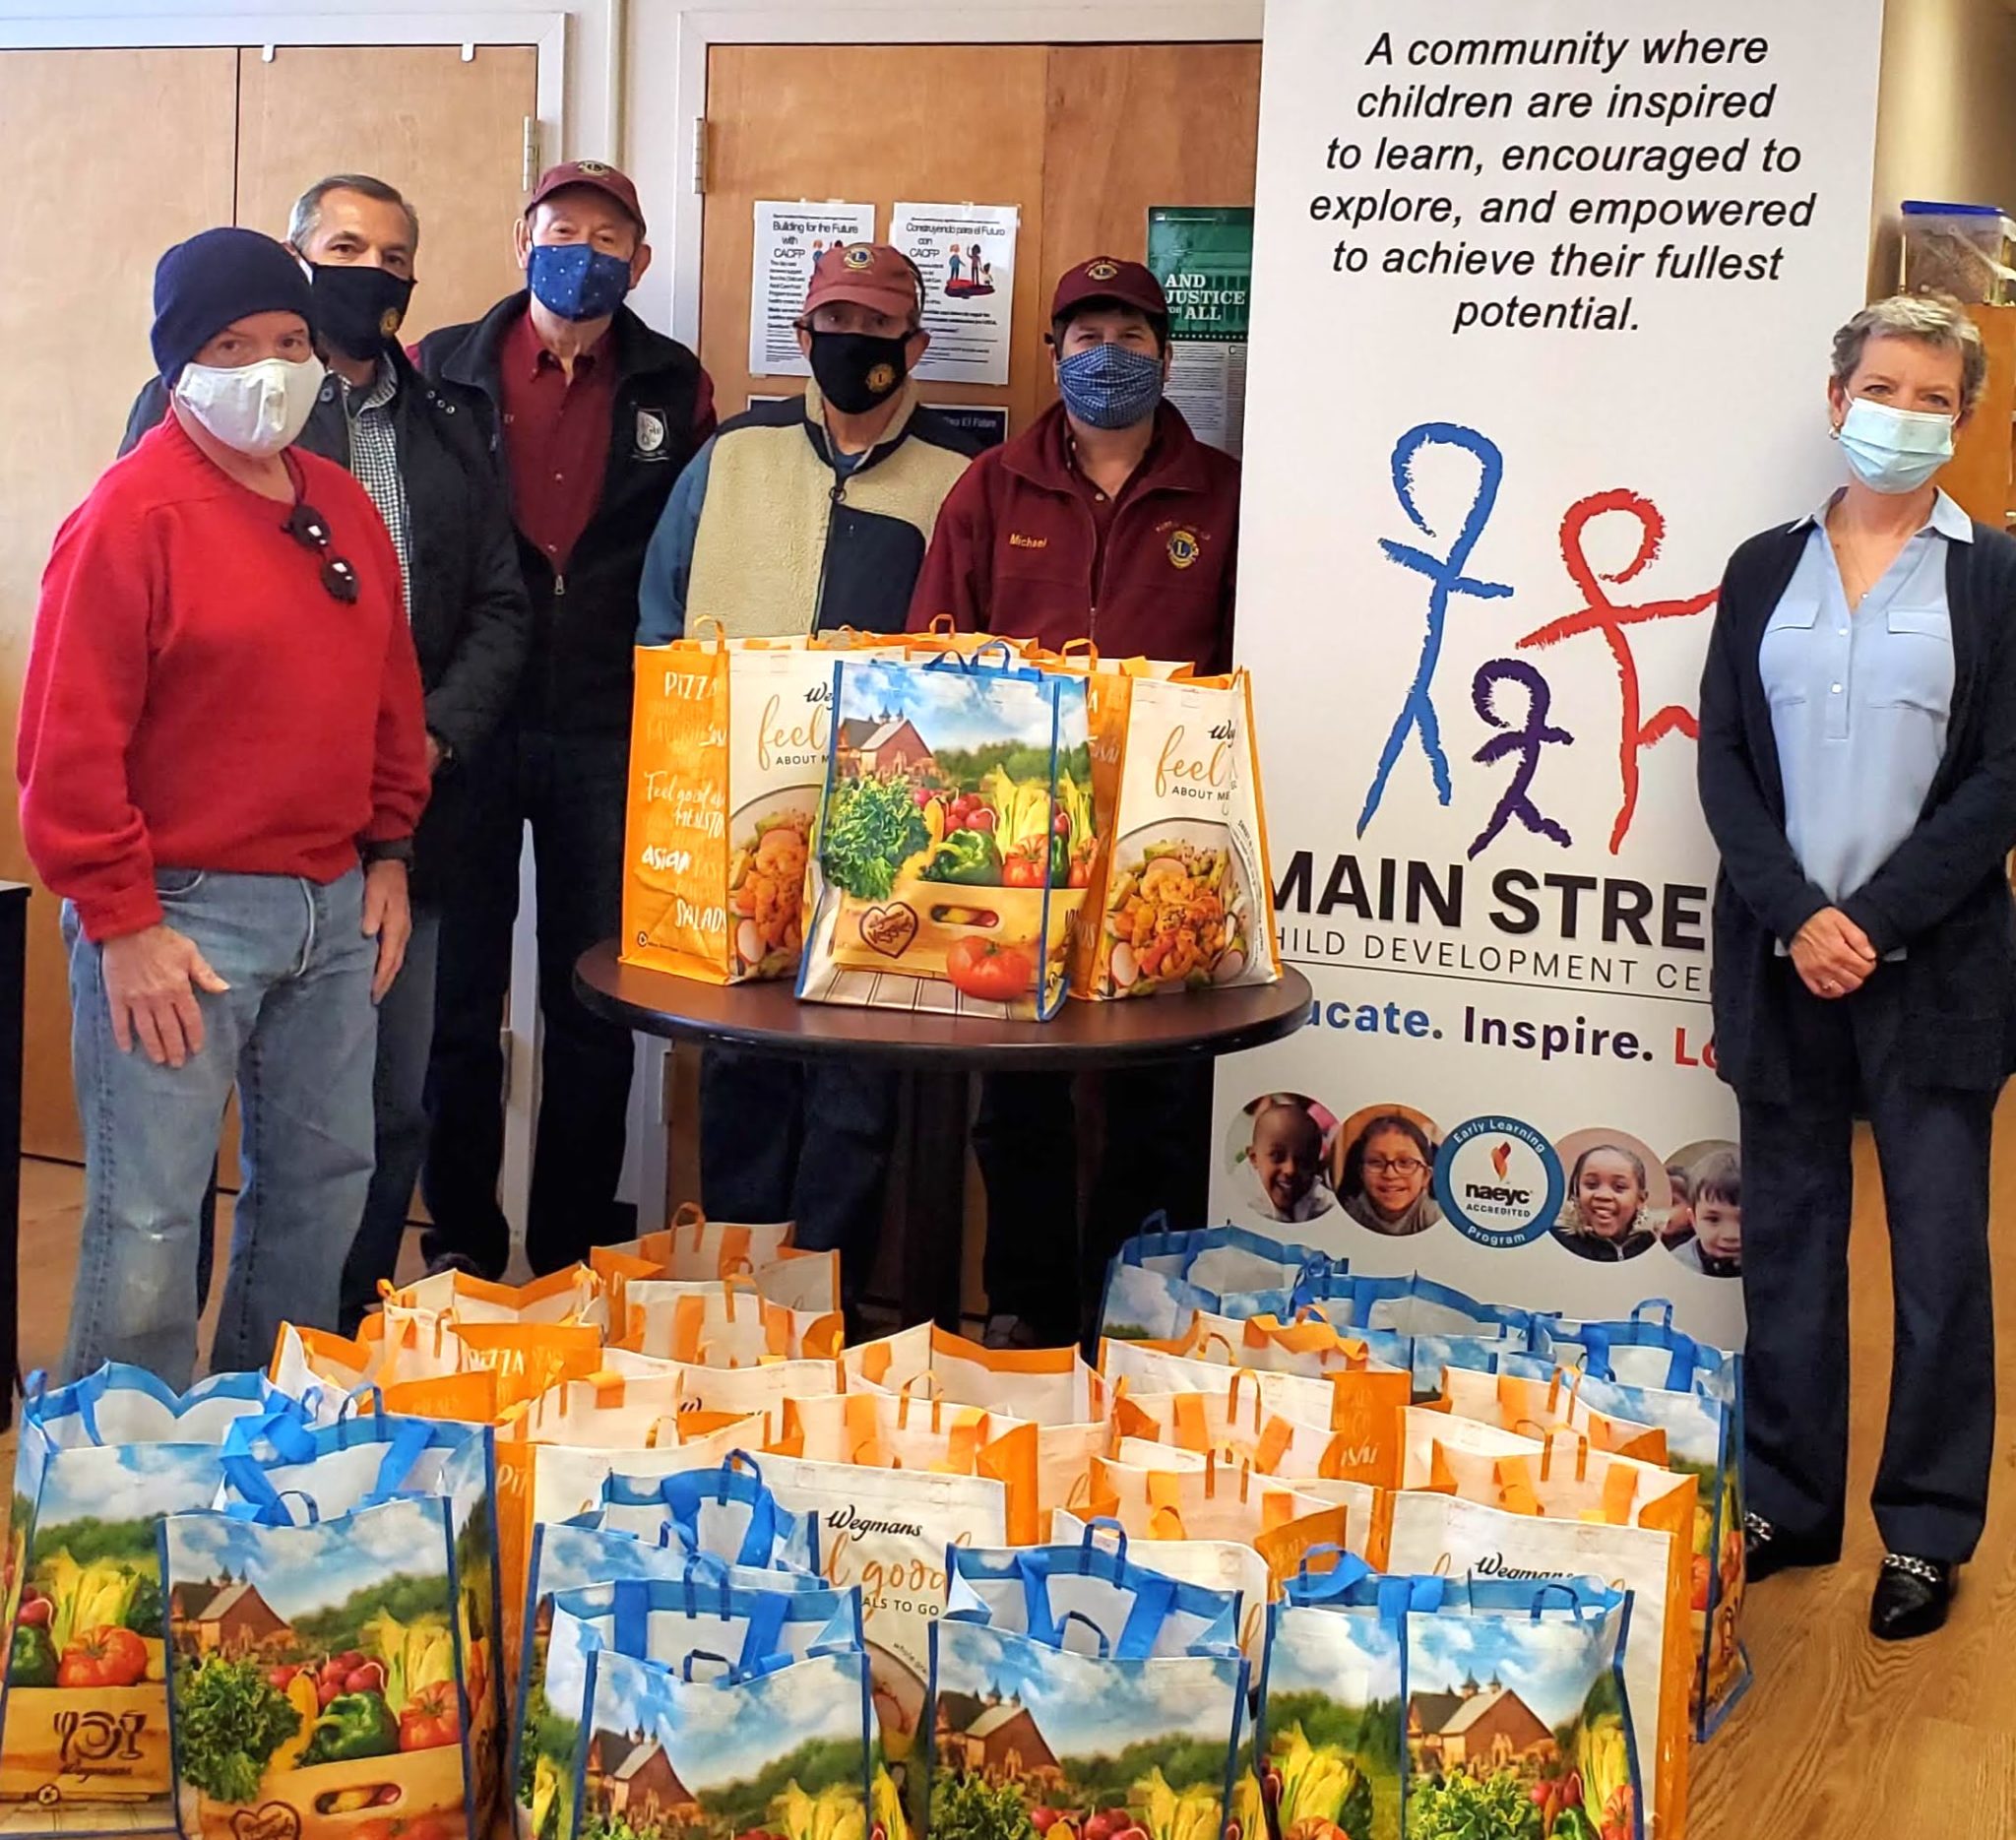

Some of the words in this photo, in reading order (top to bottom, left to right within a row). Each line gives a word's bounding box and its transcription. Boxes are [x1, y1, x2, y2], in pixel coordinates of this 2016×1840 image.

[1364, 32, 1393, 66] A
[1408, 31, 1629, 74] community
[1643, 30, 1768, 65] where
[1357, 84, 1513, 118] children
[1527, 92, 1593, 118] are
[1606, 83, 1778, 127] inspired
[1327, 137, 1361, 169] to
[1374, 136, 1482, 176] learn,
[1502, 137, 1750, 181] encouraged
[1762, 138, 1801, 173] to
[773, 221, 804, 233] Building
[806, 222, 817, 232] for
[832, 223, 858, 234] Future
[1309, 188, 1461, 229] explore,
[1480, 190, 1557, 224] and
[1569, 192, 1817, 233] empowered
[1333, 240, 1368, 273] to
[1382, 240, 1535, 276] achieve
[1550, 243, 1646, 279] their
[1656, 244, 1784, 281] fullest
[1165, 274, 1206, 288] AND
[1166, 289, 1245, 305] JUSTICE
[1184, 306, 1222, 321] ALL
[1452, 295, 1638, 335] potential.
[1009, 533, 1048, 548] Michael
[759, 693, 828, 771] feel
[776, 755, 817, 766] ABOUT
[1156, 724, 1228, 798] feel
[1171, 785, 1213, 800] ABOUT
[1488, 868, 1708, 951] STRE
[1364, 934, 1639, 984] DEVELOPMENT
[1657, 963, 1716, 992] CE
[1464, 1005, 1654, 1060] Inspire.
[1453, 1122, 1484, 1144] Early
[1489, 1119, 1545, 1154] Learning
[1465, 1183, 1531, 1206] naeyc
[1466, 1203, 1532, 1218] ACCREDITED
[1468, 1226, 1526, 1246] Program
[824, 1504, 923, 1542] Wegmans
[894, 1599, 913, 1613] TO
[917, 1603, 940, 1617] GO
